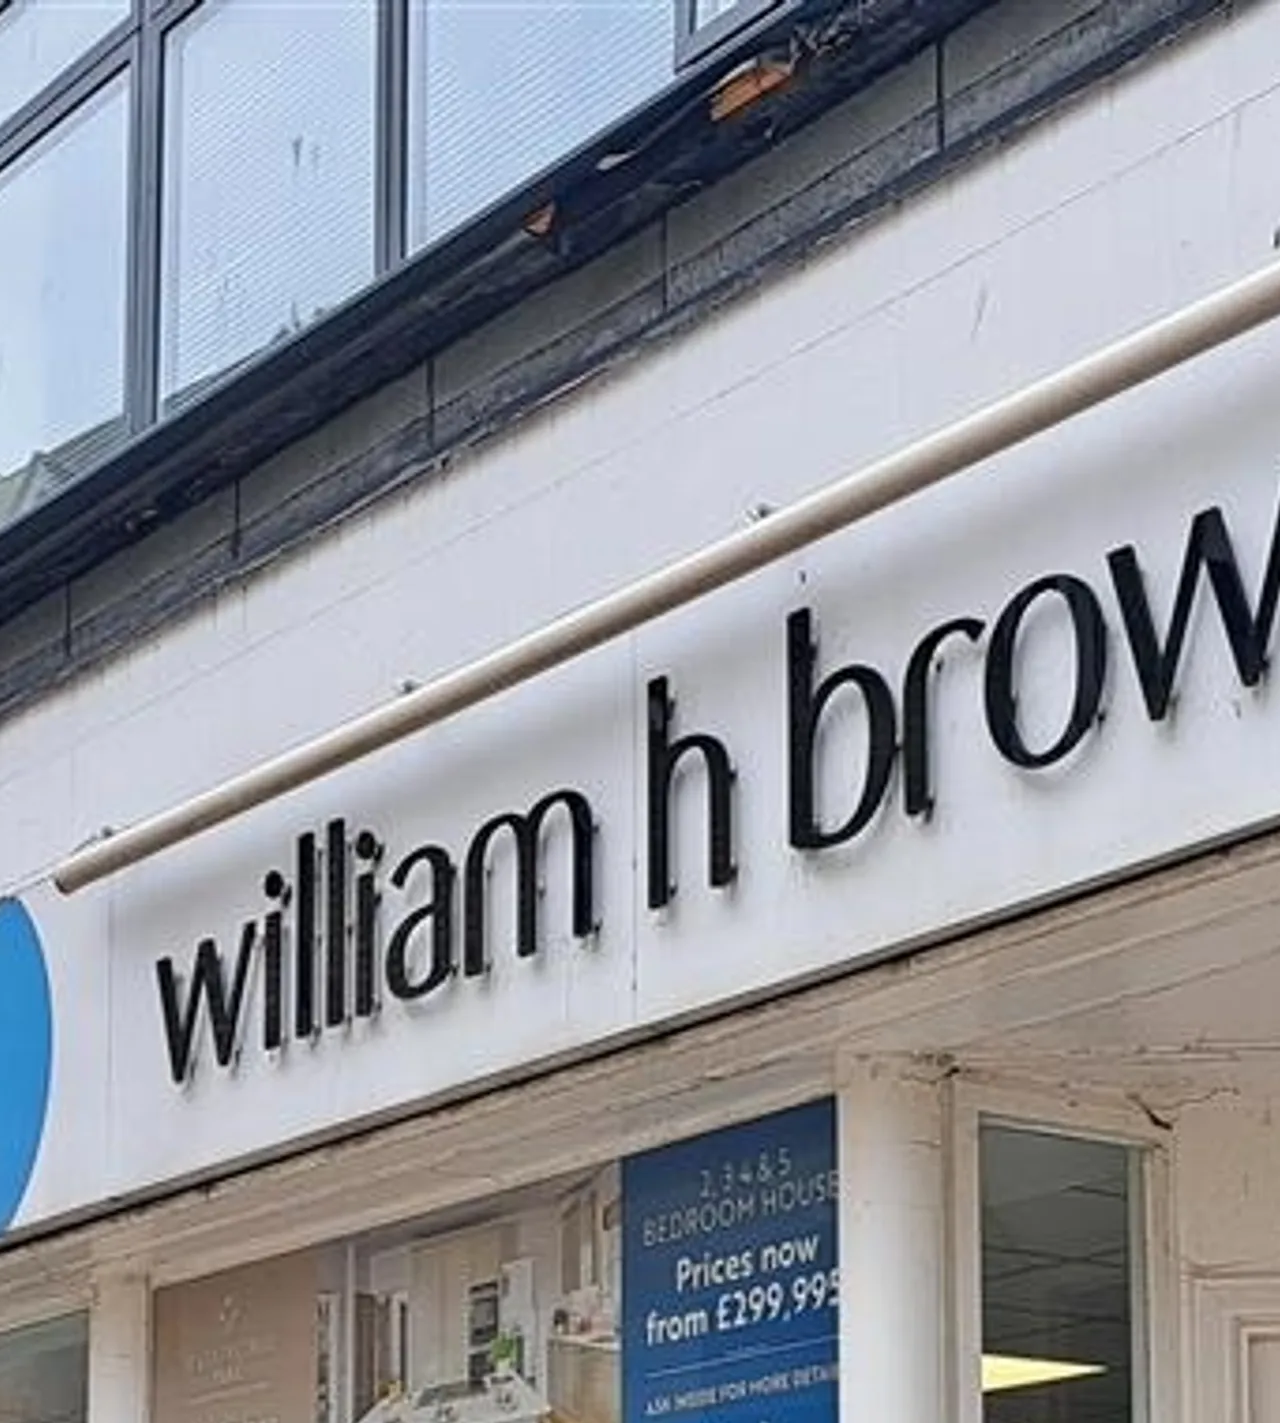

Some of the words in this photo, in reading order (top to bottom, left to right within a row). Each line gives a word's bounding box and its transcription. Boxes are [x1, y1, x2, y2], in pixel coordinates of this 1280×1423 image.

[157, 788, 600, 1084] william
[648, 674, 737, 910] h
[643, 1194, 756, 1247] BEDROOM
[676, 1252, 754, 1292] Prices
[759, 1233, 819, 1271] now
[646, 1307, 709, 1346] from
